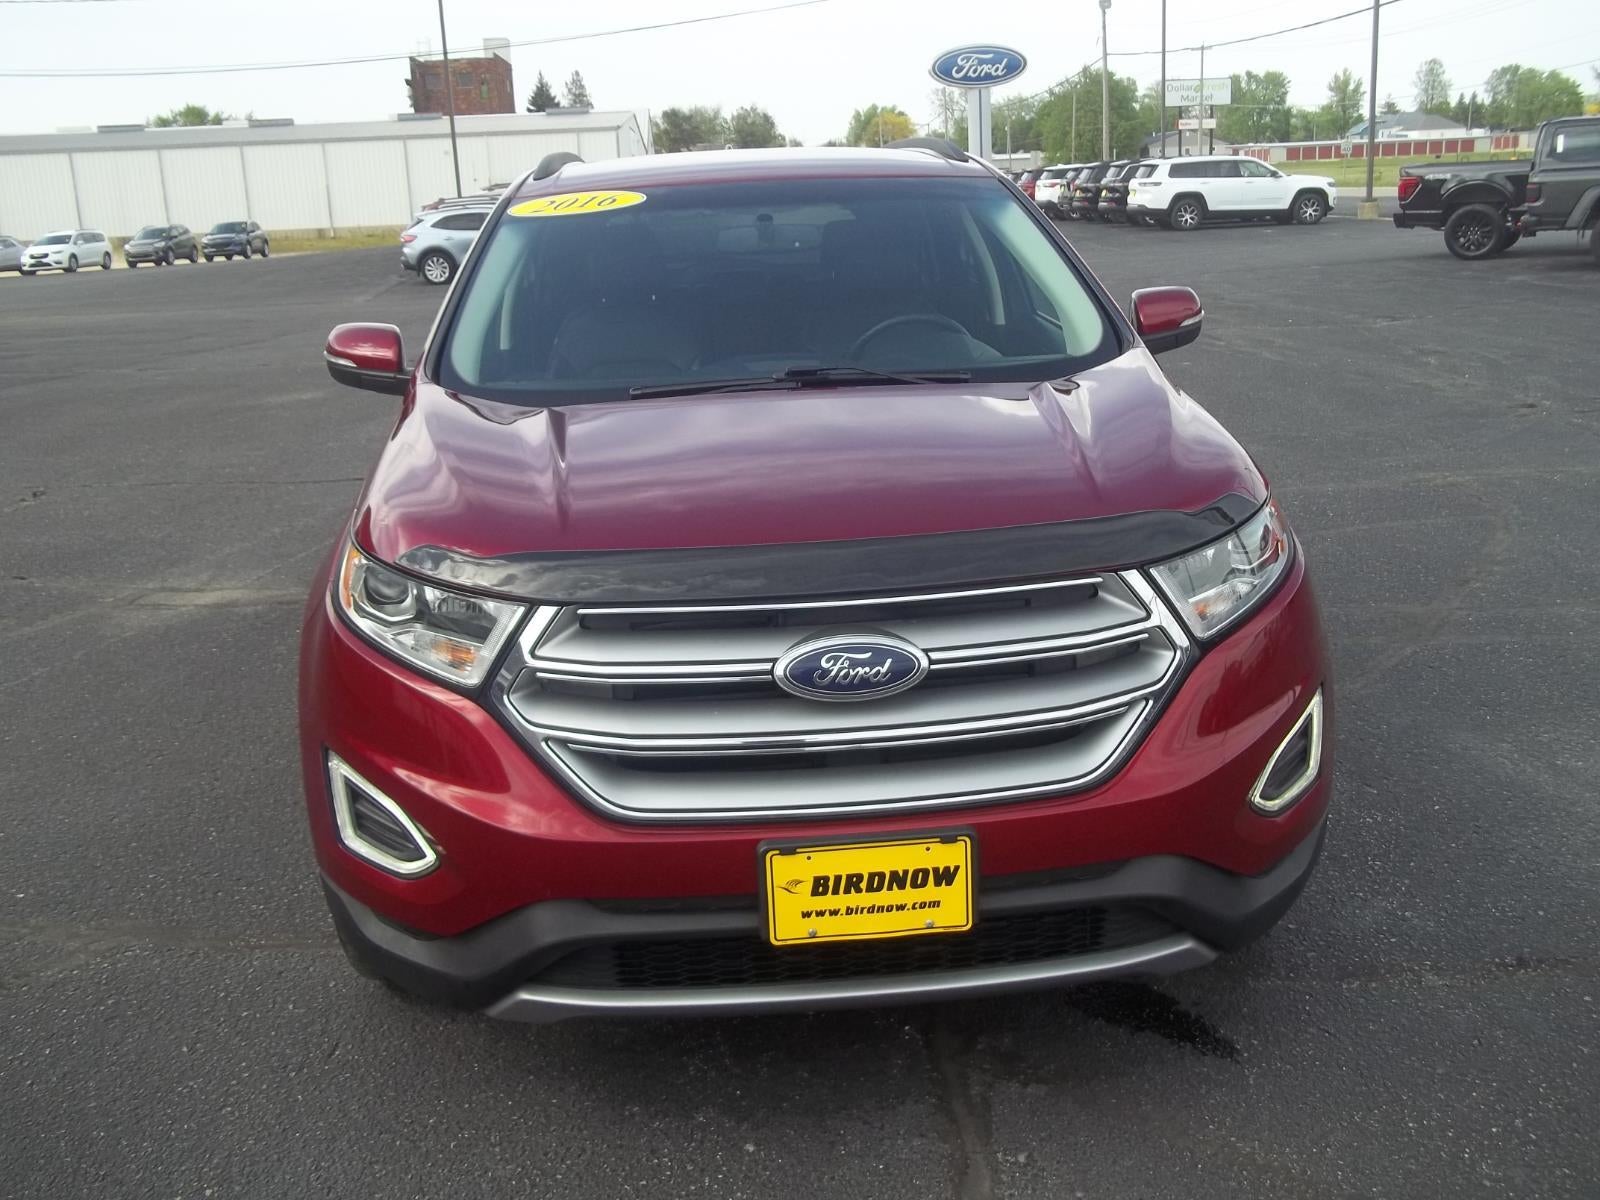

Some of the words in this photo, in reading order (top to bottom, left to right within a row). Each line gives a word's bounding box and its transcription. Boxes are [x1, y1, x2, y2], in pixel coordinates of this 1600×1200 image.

[952, 53, 1008, 78] Ford
[1166, 83, 1193, 92] Dollar
[1180, 93, 1213, 103] Maret
[529, 194, 623, 213] 2016
[813, 651, 893, 685] Ford
[810, 865, 960, 897] BIRDNOW
[800, 899, 942, 919] www.birdnow.com
